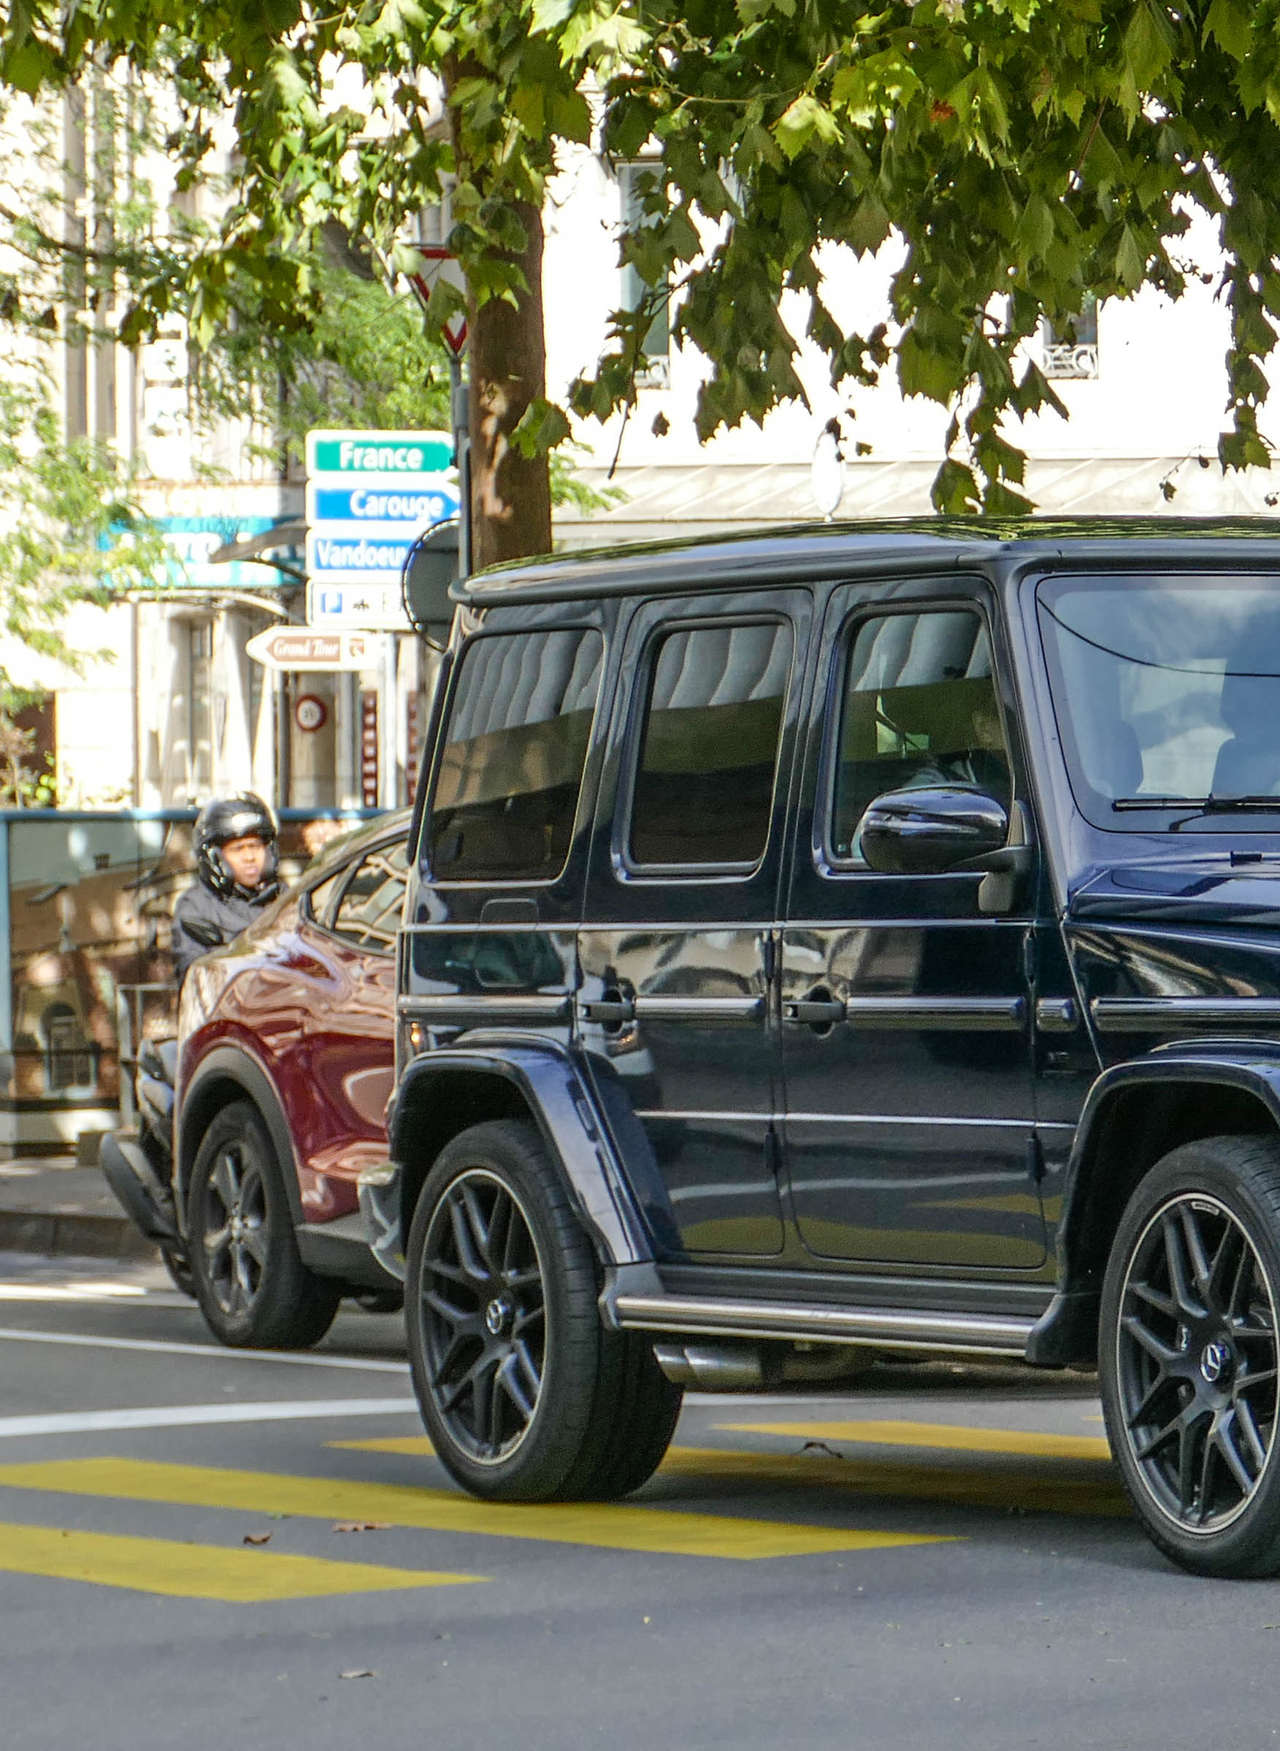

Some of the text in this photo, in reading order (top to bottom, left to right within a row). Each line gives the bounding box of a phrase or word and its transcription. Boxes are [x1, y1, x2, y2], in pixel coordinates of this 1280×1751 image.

[339, 441, 423, 469] France
[350, 489, 444, 522] Carouge
[273, 638, 339, 657] Grand Tour
